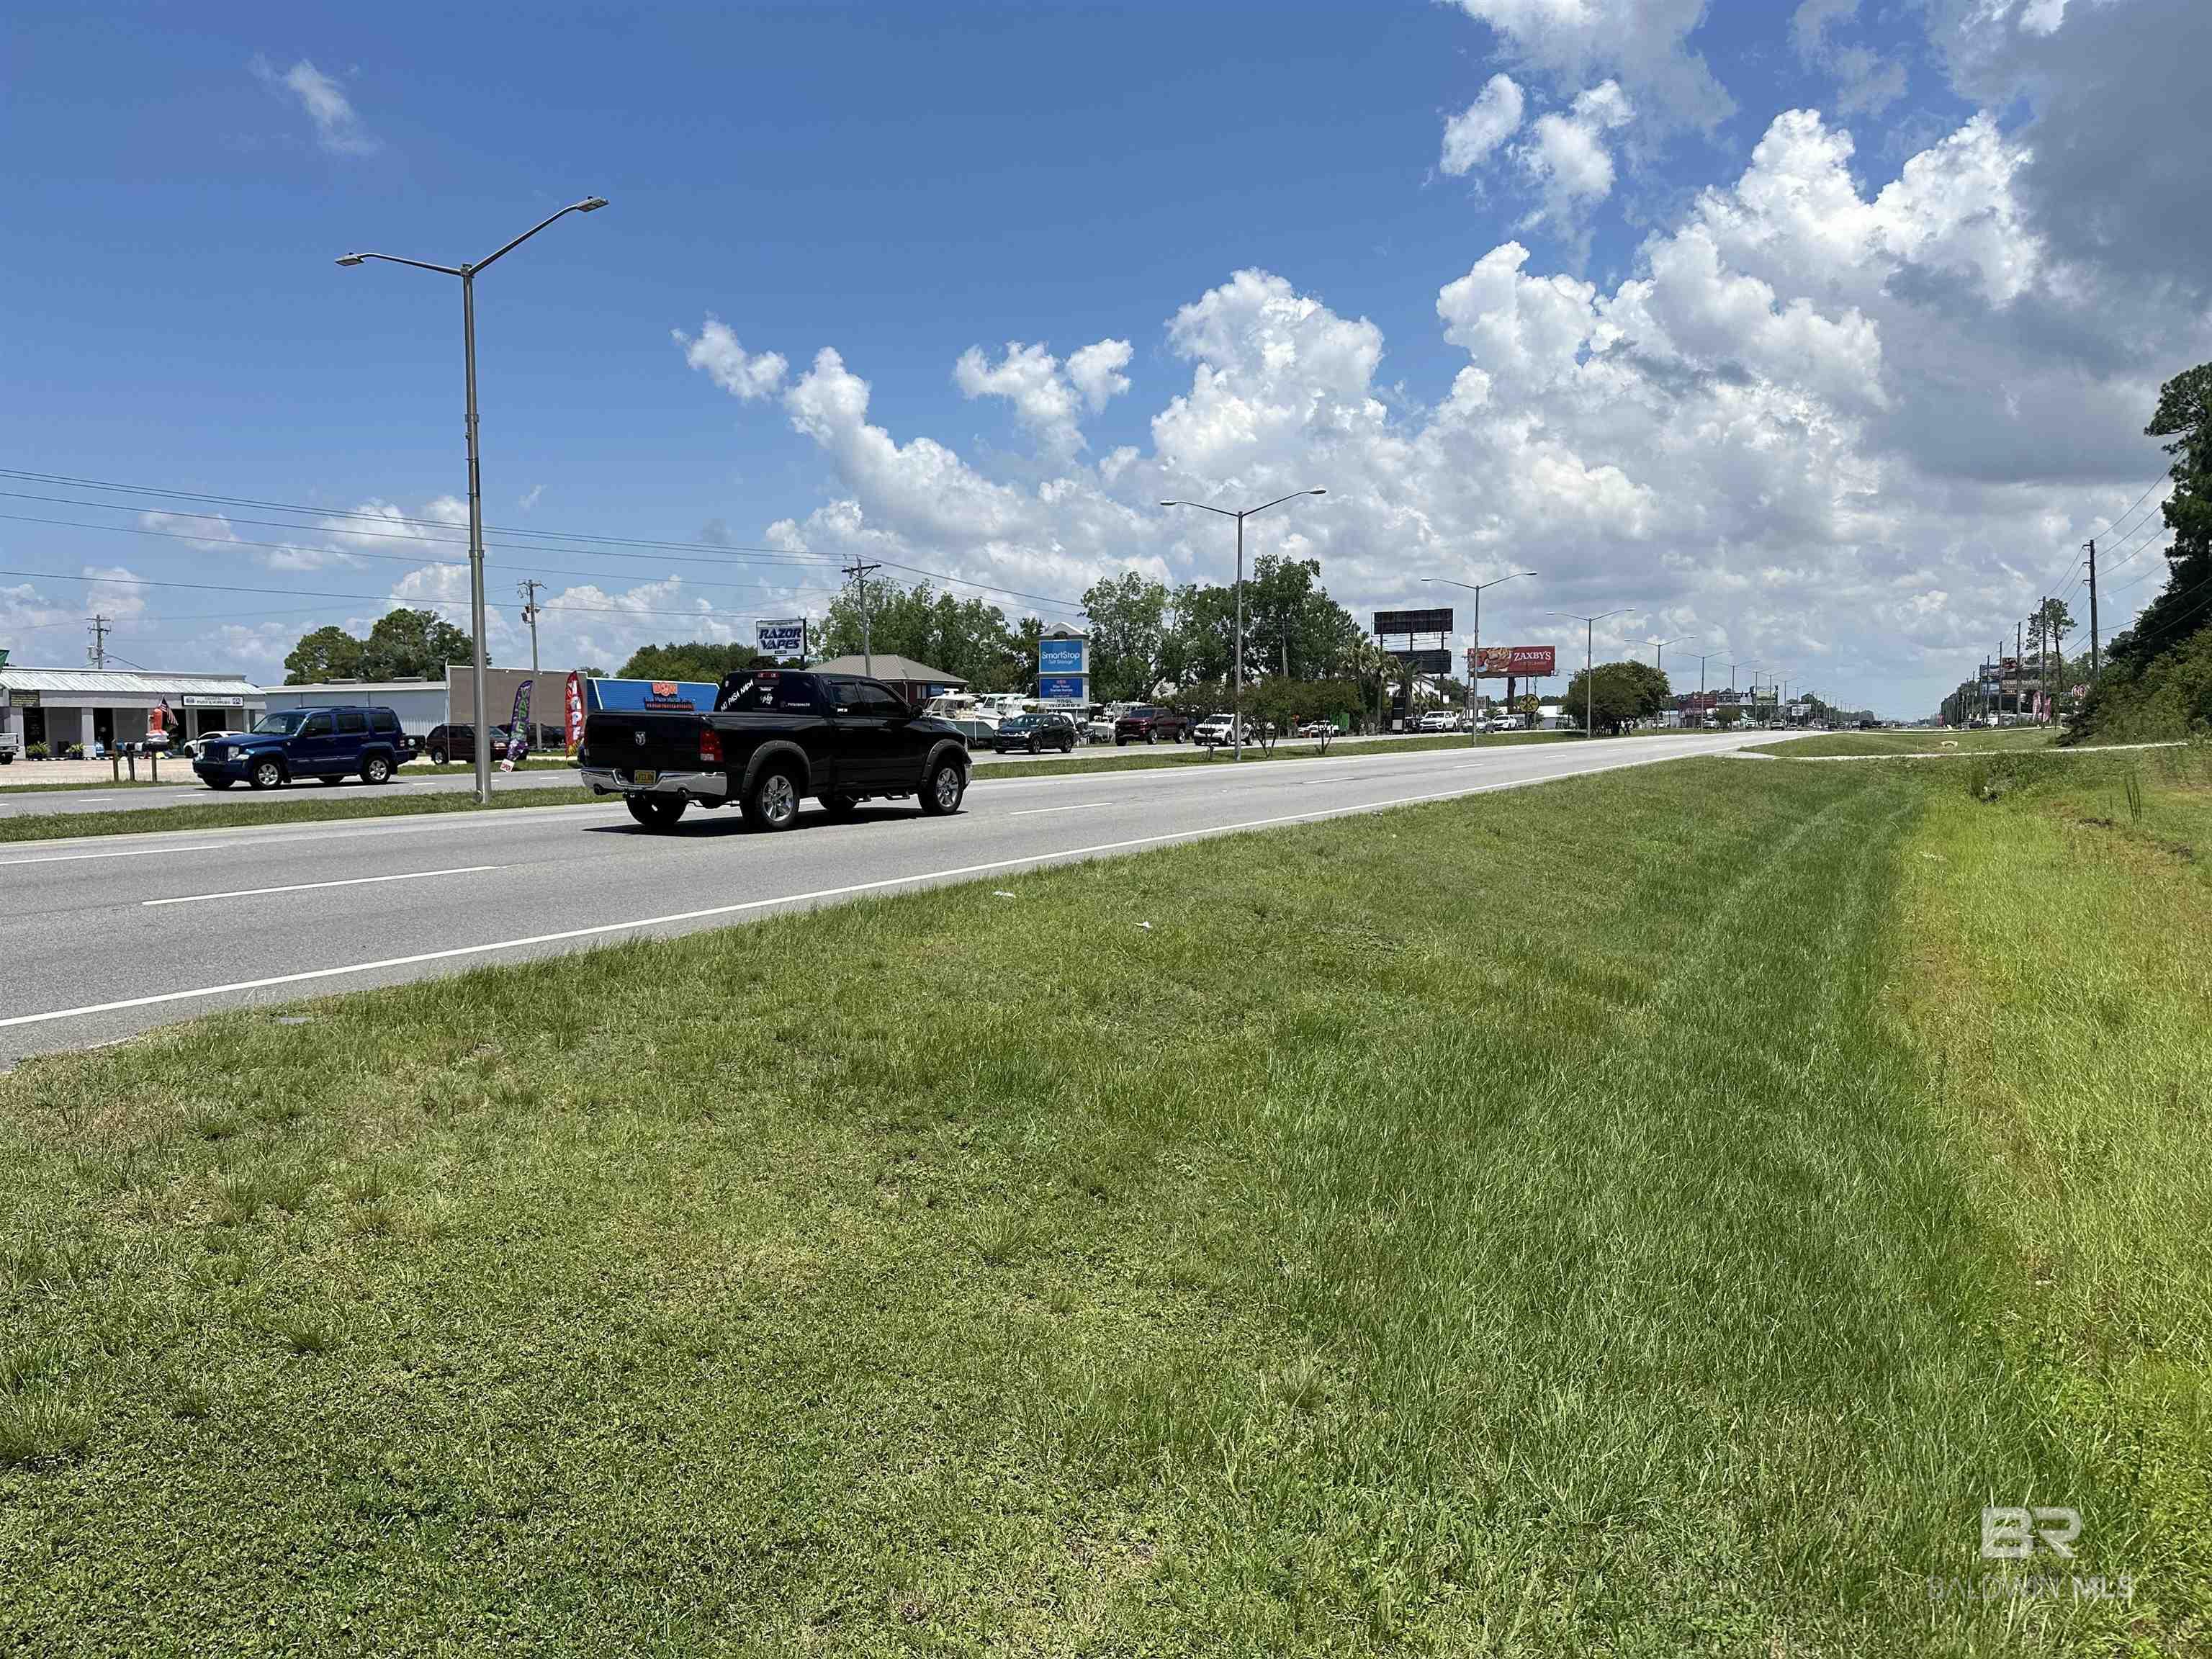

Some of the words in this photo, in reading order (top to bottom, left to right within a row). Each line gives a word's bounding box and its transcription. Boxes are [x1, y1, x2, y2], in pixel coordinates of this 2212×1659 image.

[759, 628, 801, 639] RAZOR
[760, 639, 800, 649] VAPES
[1042, 651, 1080, 660] SmartStop
[1514, 651, 1552, 661] ZAXBY'S
